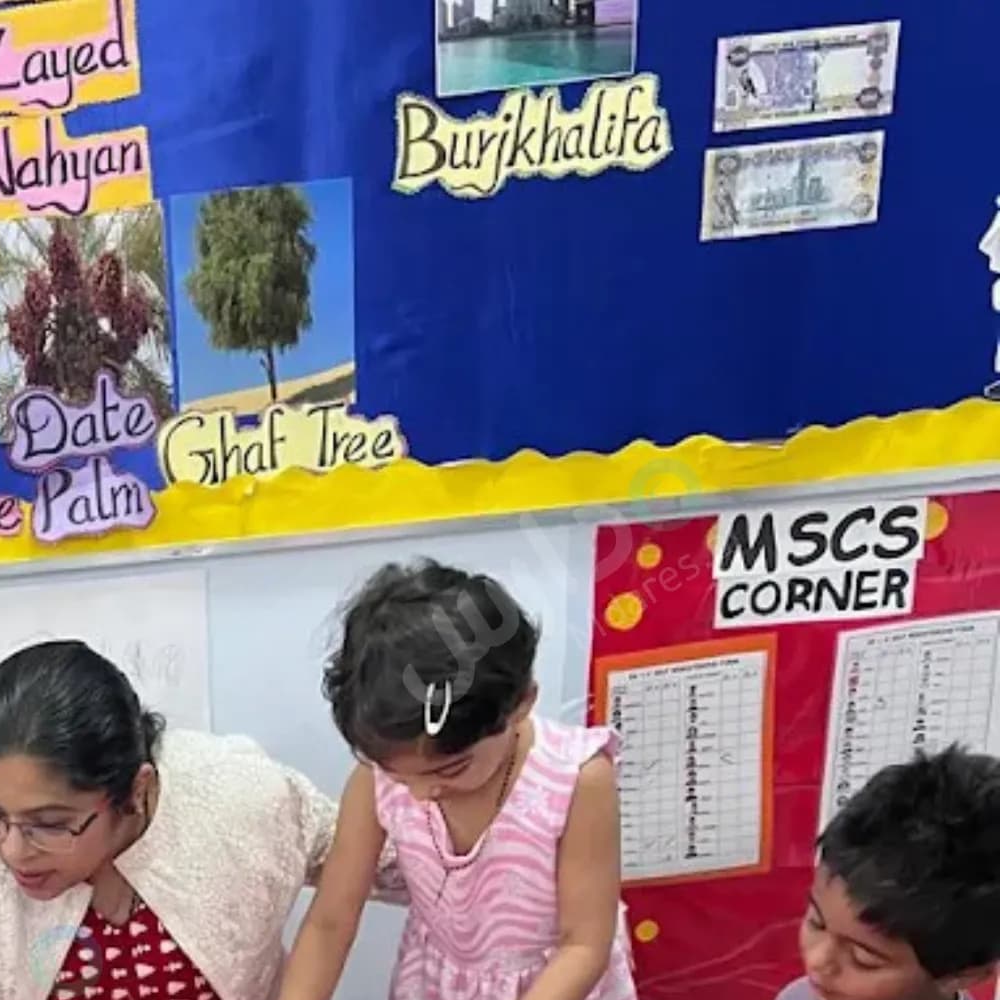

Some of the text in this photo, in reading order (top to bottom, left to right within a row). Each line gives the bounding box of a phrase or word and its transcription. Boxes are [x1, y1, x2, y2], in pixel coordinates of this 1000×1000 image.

[399, 85, 663, 195] Burjkhalifa
[14, 377, 154, 459] Date
[164, 402, 397, 486] Ghaf Tree
[39, 460, 145, 533] Palm
[719, 504, 920, 573] MSCS
[719, 568, 910, 618] CORNER
